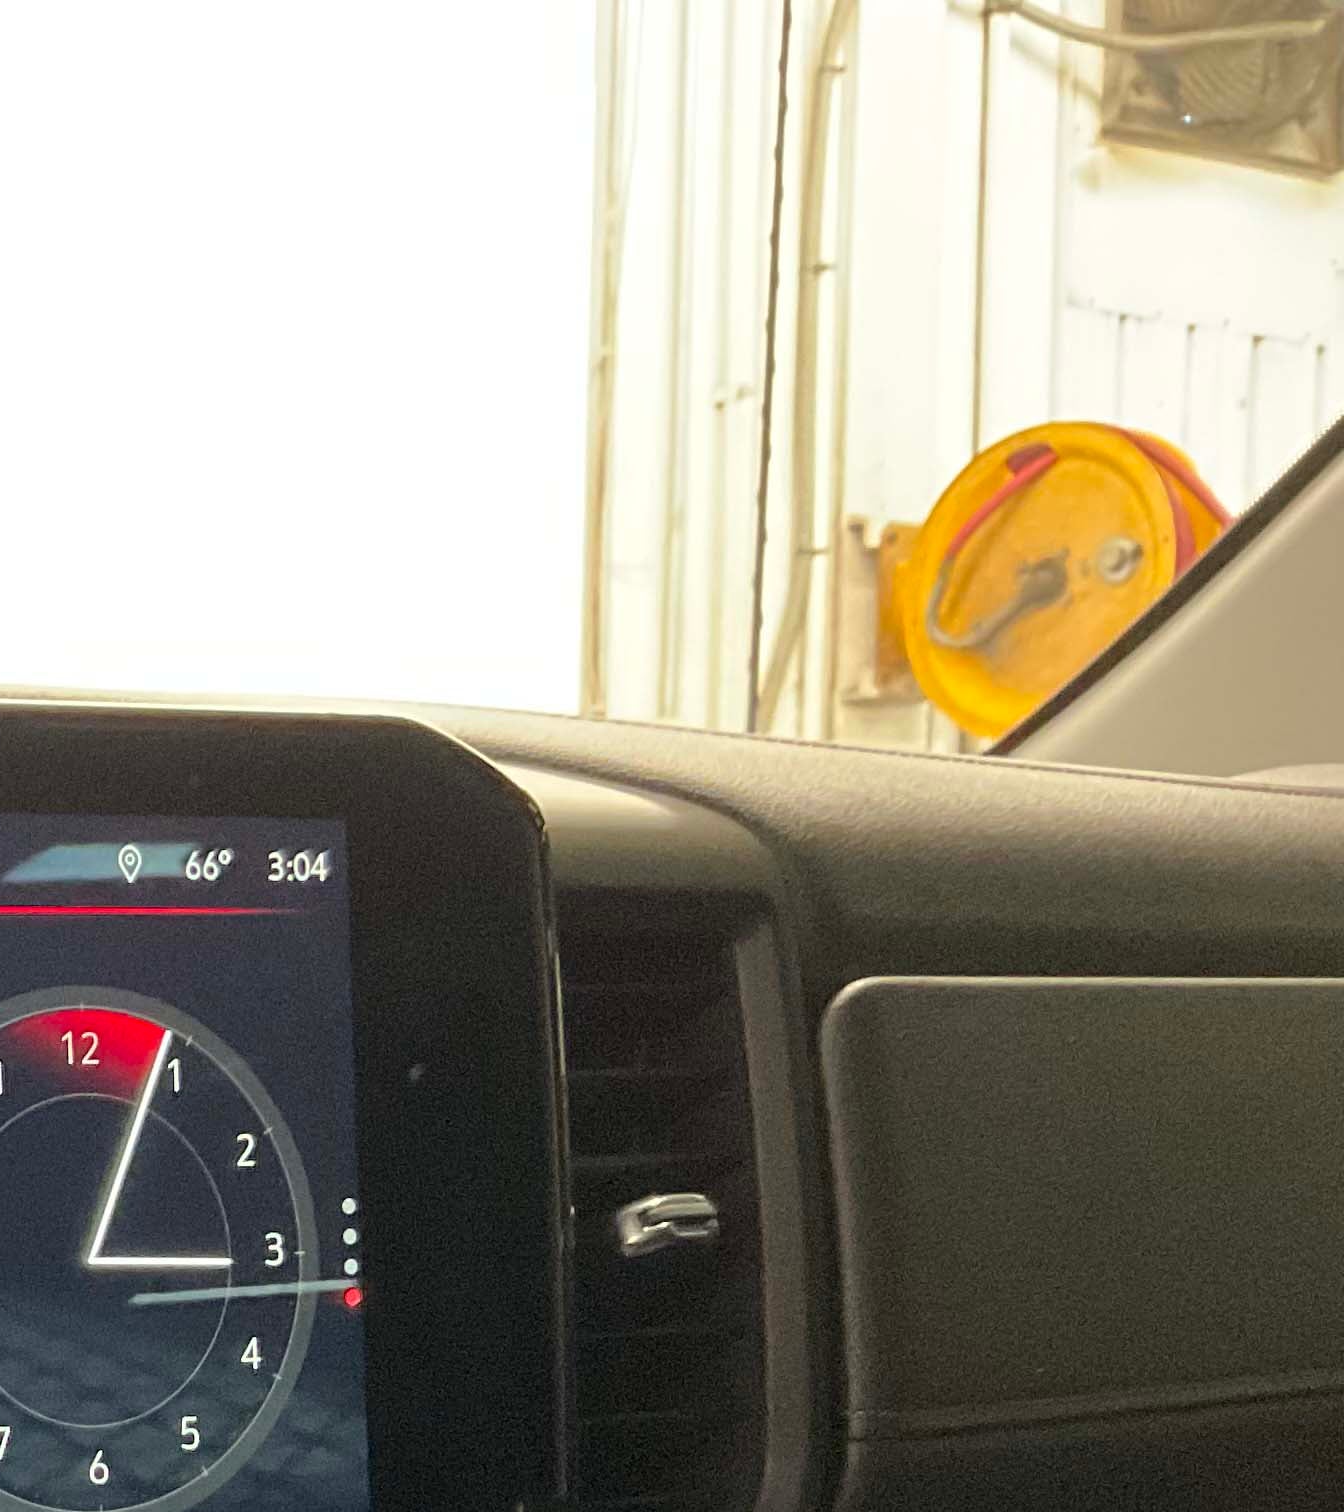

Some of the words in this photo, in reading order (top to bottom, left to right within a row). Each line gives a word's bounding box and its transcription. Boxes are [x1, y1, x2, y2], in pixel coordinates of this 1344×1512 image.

[185, 849, 233, 881] 66°
[267, 851, 329, 882] 3:04
[60, 1031, 100, 1066] 12
[167, 1059, 183, 1093] 1
[236, 1134, 257, 1167] 2
[263, 1234, 285, 1268] 3
[240, 1338, 262, 1371] 4
[180, 1417, 201, 1451] 5
[89, 1451, 110, 1485] 6
